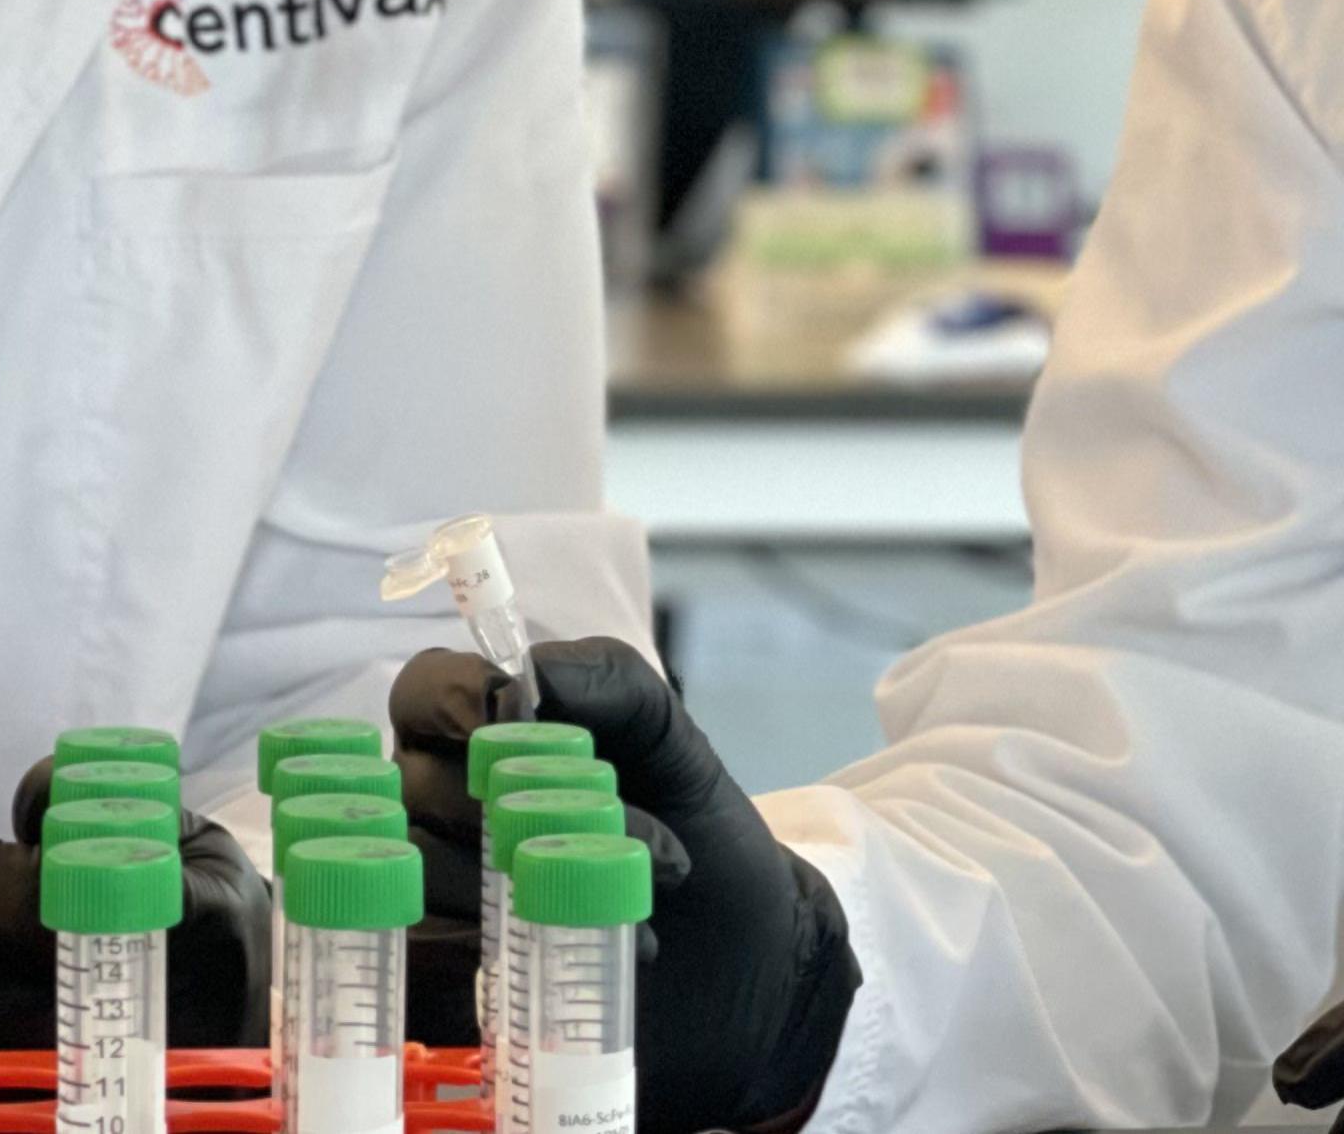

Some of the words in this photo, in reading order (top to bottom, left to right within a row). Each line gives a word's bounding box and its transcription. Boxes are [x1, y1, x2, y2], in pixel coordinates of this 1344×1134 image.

[93, 933, 158, 955] 15mL
[94, 962, 122, 982] 14
[94, 999, 125, 1021] 13
[95, 1037, 125, 1059] 12
[95, 1076, 125, 1098] 11
[96, 1115, 125, 1134] 10
